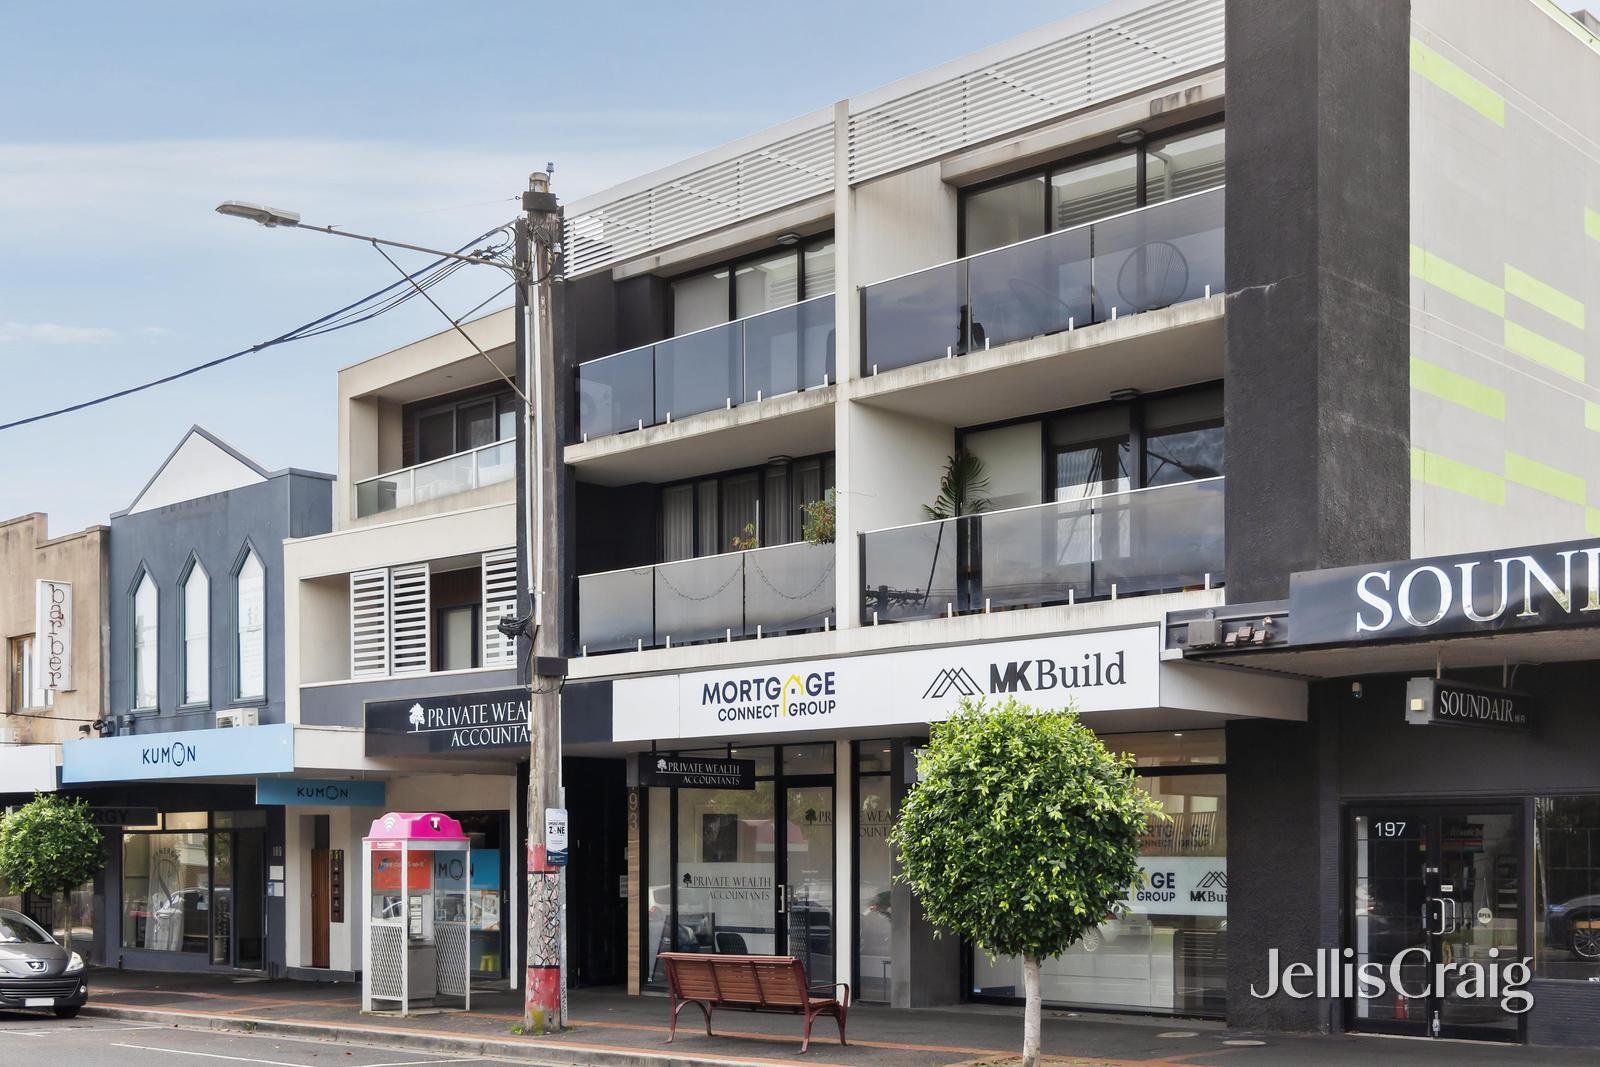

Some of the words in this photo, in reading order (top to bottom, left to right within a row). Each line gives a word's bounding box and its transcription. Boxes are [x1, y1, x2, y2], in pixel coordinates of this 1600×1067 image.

[48, 583, 65, 688] barber
[717, 704, 780, 722] CONNECT
[788, 699, 836, 717] GROUP
[1440, 690, 1514, 722] SOUNDAIR
[428, 703, 488, 728] PRIVATE
[450, 725, 532, 748] ACCOUNTA
[142, 741, 197, 767] KUMON
[668, 762, 704, 773] PRIVATE
[705, 763, 740, 774] WEALTH
[683, 775, 740, 785] ACCOUNTANTS
[296, 785, 350, 800] KUMON
[1375, 822, 1406, 837] 197
[693, 876, 729, 887] PRIVATE
[732, 876, 771, 888] WEALTH
[709, 890, 770, 900] ACCOUNTANTS
[1136, 891, 1176, 902] GROUP
